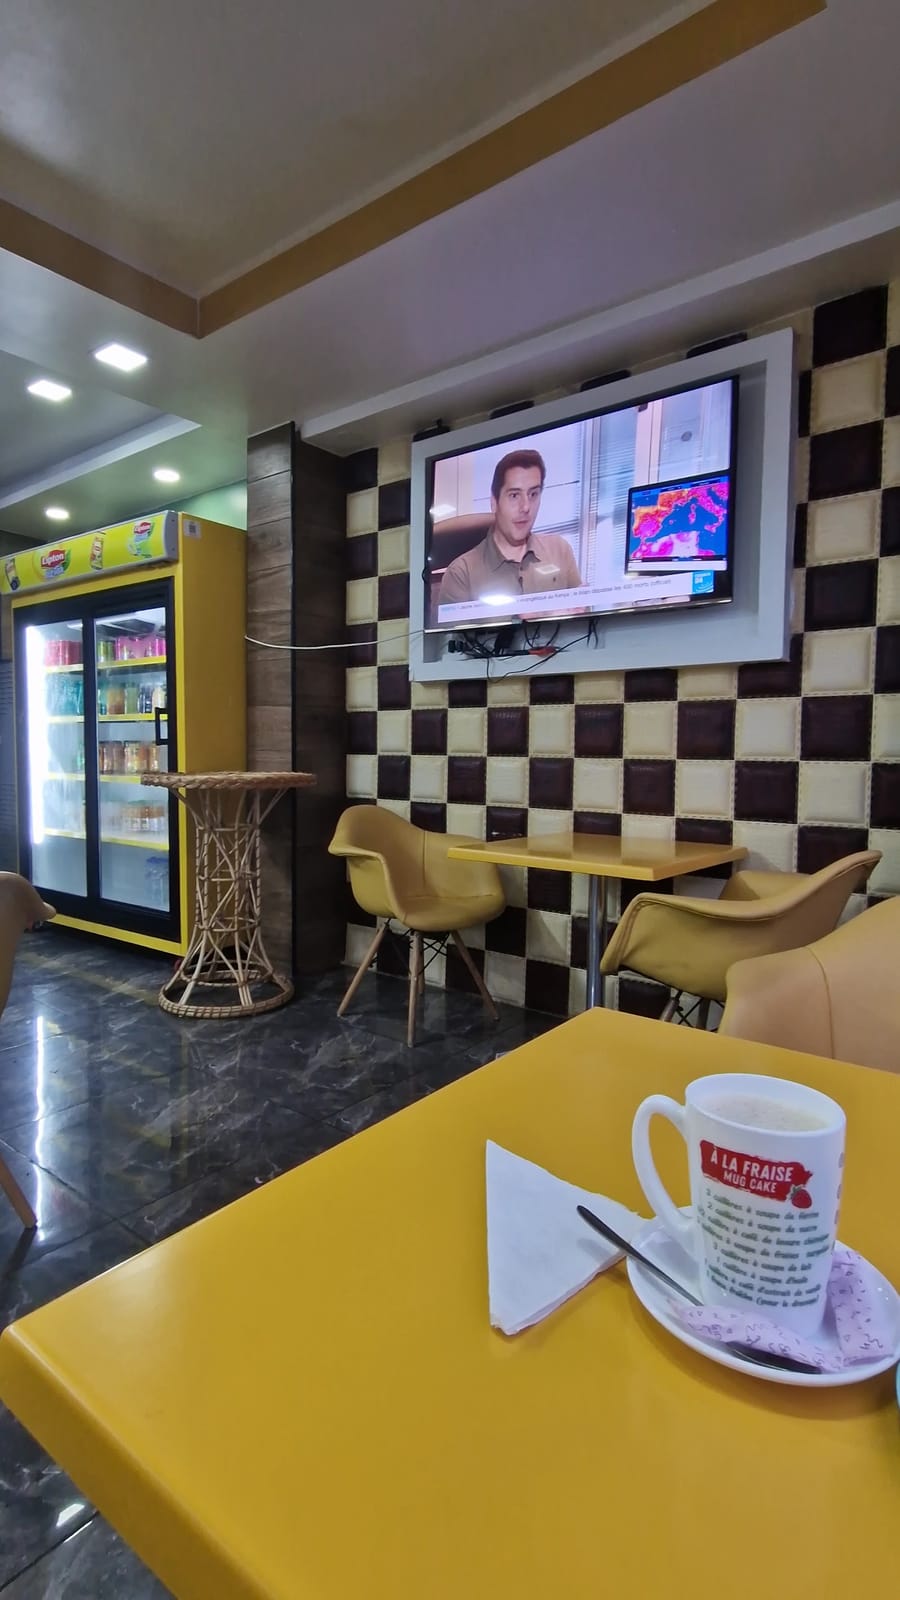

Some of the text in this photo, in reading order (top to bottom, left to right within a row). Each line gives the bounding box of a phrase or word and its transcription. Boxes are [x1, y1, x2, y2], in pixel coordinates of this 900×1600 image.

[42, 552, 65, 567] Lipton
[711, 1146, 794, 1182] À LA FRAISE
[723, 1171, 777, 1193] MUG CAKE
[756, 1210, 780, 1219] soupe
[784, 1212, 794, 1220] de
[757, 1223, 781, 1233] soupe
[785, 1225, 795, 1233] de
[762, 1236, 772, 1244] de
[760, 1248, 770, 1256] de
[761, 1263, 784, 1272] soupe
[788, 1263, 797, 1271] de
[760, 1275, 782, 1284] soupe
